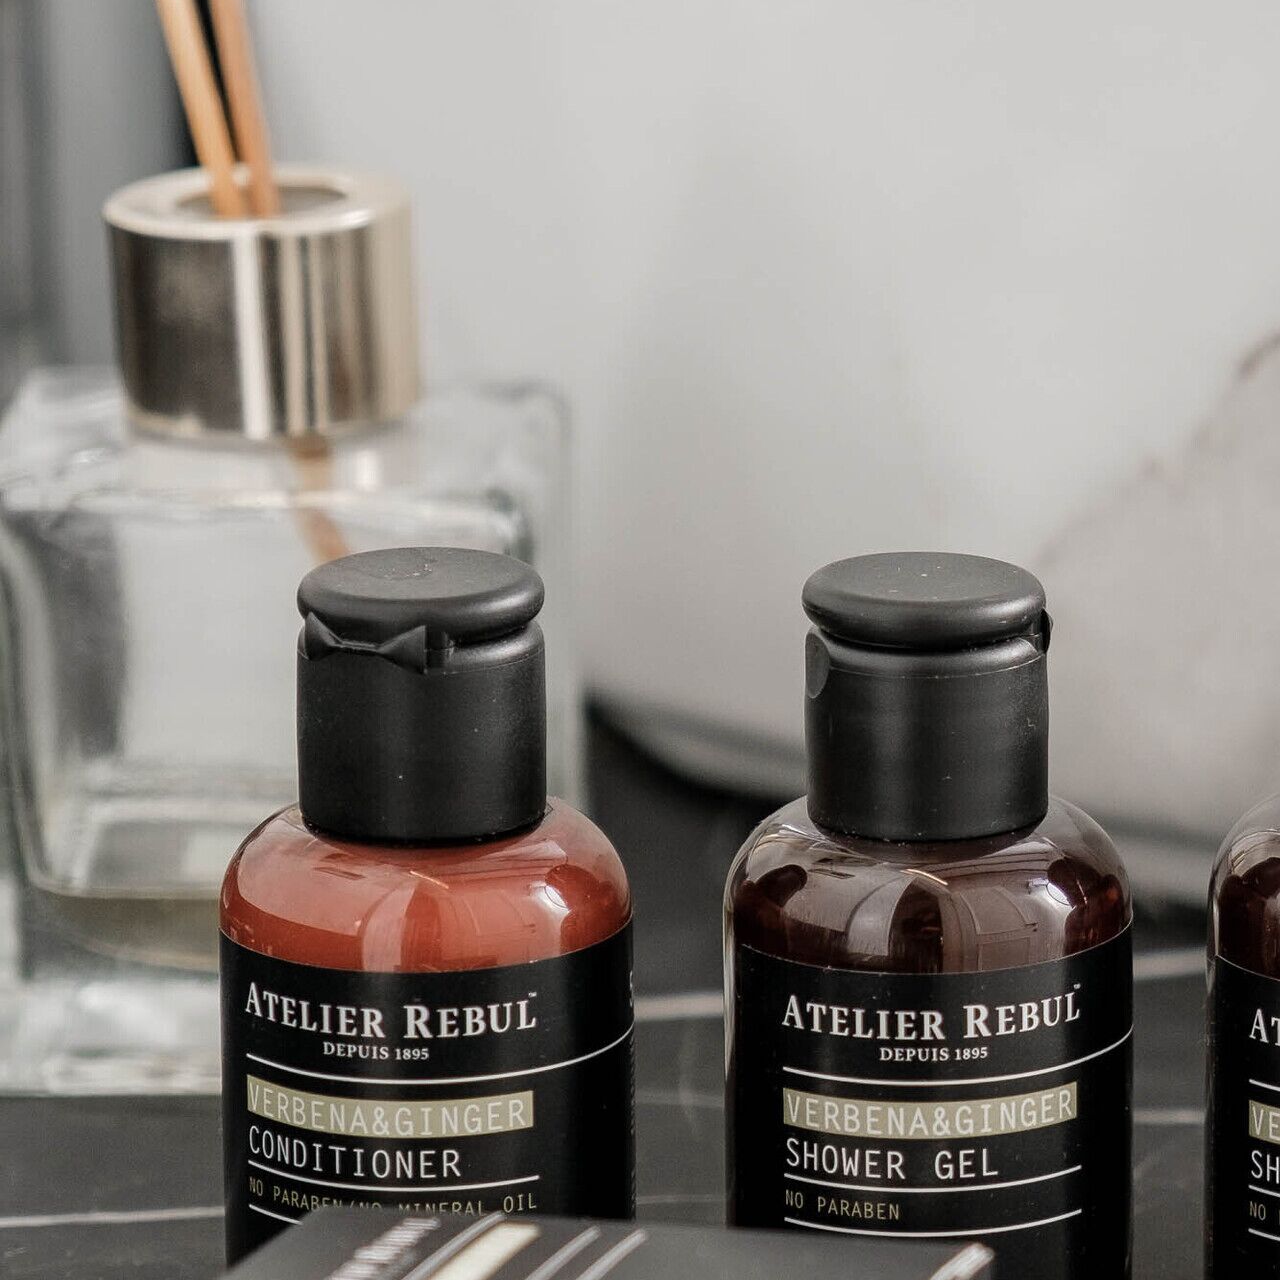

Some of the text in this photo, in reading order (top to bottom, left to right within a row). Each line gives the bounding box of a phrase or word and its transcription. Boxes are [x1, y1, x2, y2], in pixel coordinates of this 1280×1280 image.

[245, 982, 385, 1038] ATELIER
[782, 995, 946, 1040] ATELIER
[323, 1041, 430, 1061] DEPUIS 1895
[880, 1046, 988, 1062] DEPUIS 1895
[249, 1083, 524, 1136] VERBENA&GINGER
[787, 1090, 1073, 1137] VERBENA&GINGER
[249, 1126, 462, 1179] CONDITIONER
[786, 1139, 998, 1180] SHOWER GEL
[249, 1176, 264, 1197] NO
[503, 1192, 537, 1213] OIL
[785, 1190, 900, 1220] NO PARABEN
[1249, 1200, 1266, 1221] NO
